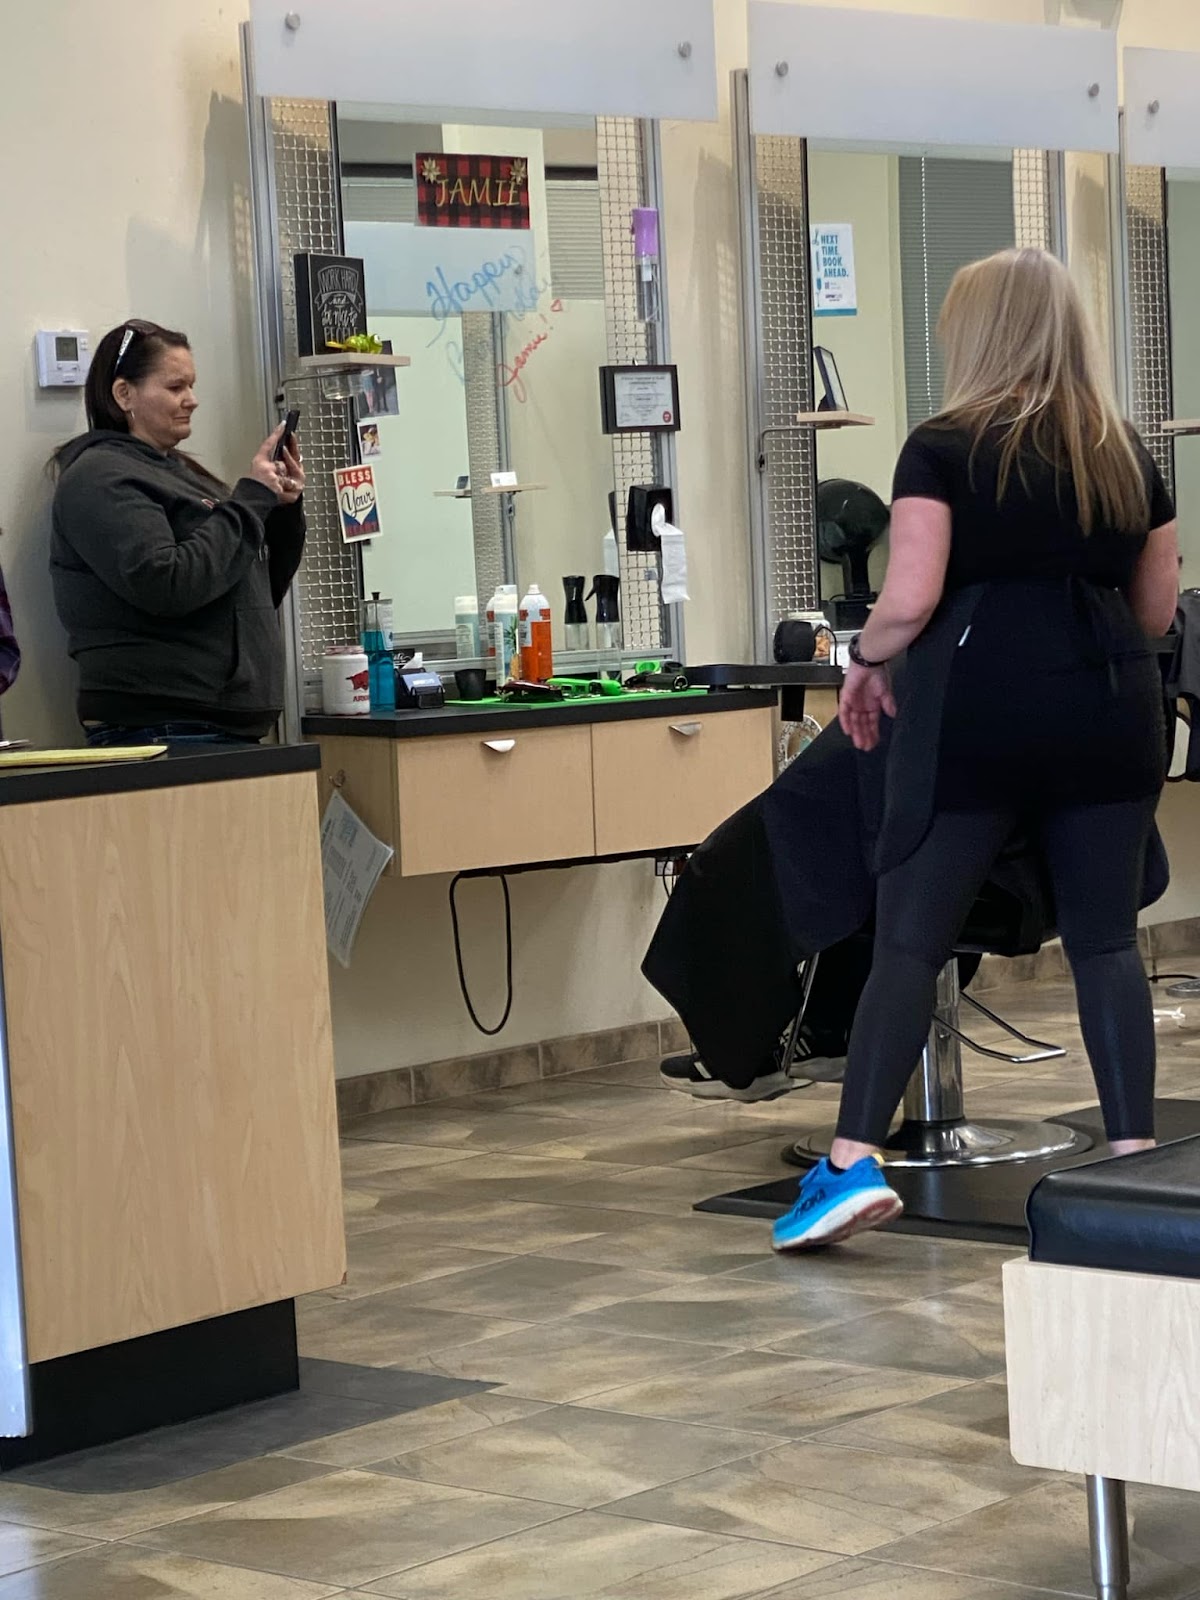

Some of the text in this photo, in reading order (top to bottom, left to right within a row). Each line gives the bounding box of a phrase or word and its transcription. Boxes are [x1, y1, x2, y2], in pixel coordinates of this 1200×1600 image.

[435, 177, 521, 207] JAMIE
[820, 234, 838, 245] NEXT
[821, 245, 839, 256] TIME
[822, 256, 843, 267] BOOK
[823, 267, 849, 278] AHEAD.
[425, 245, 526, 348] Happy
[337, 470, 371, 486] BLESS
[341, 489, 375, 518] Your
